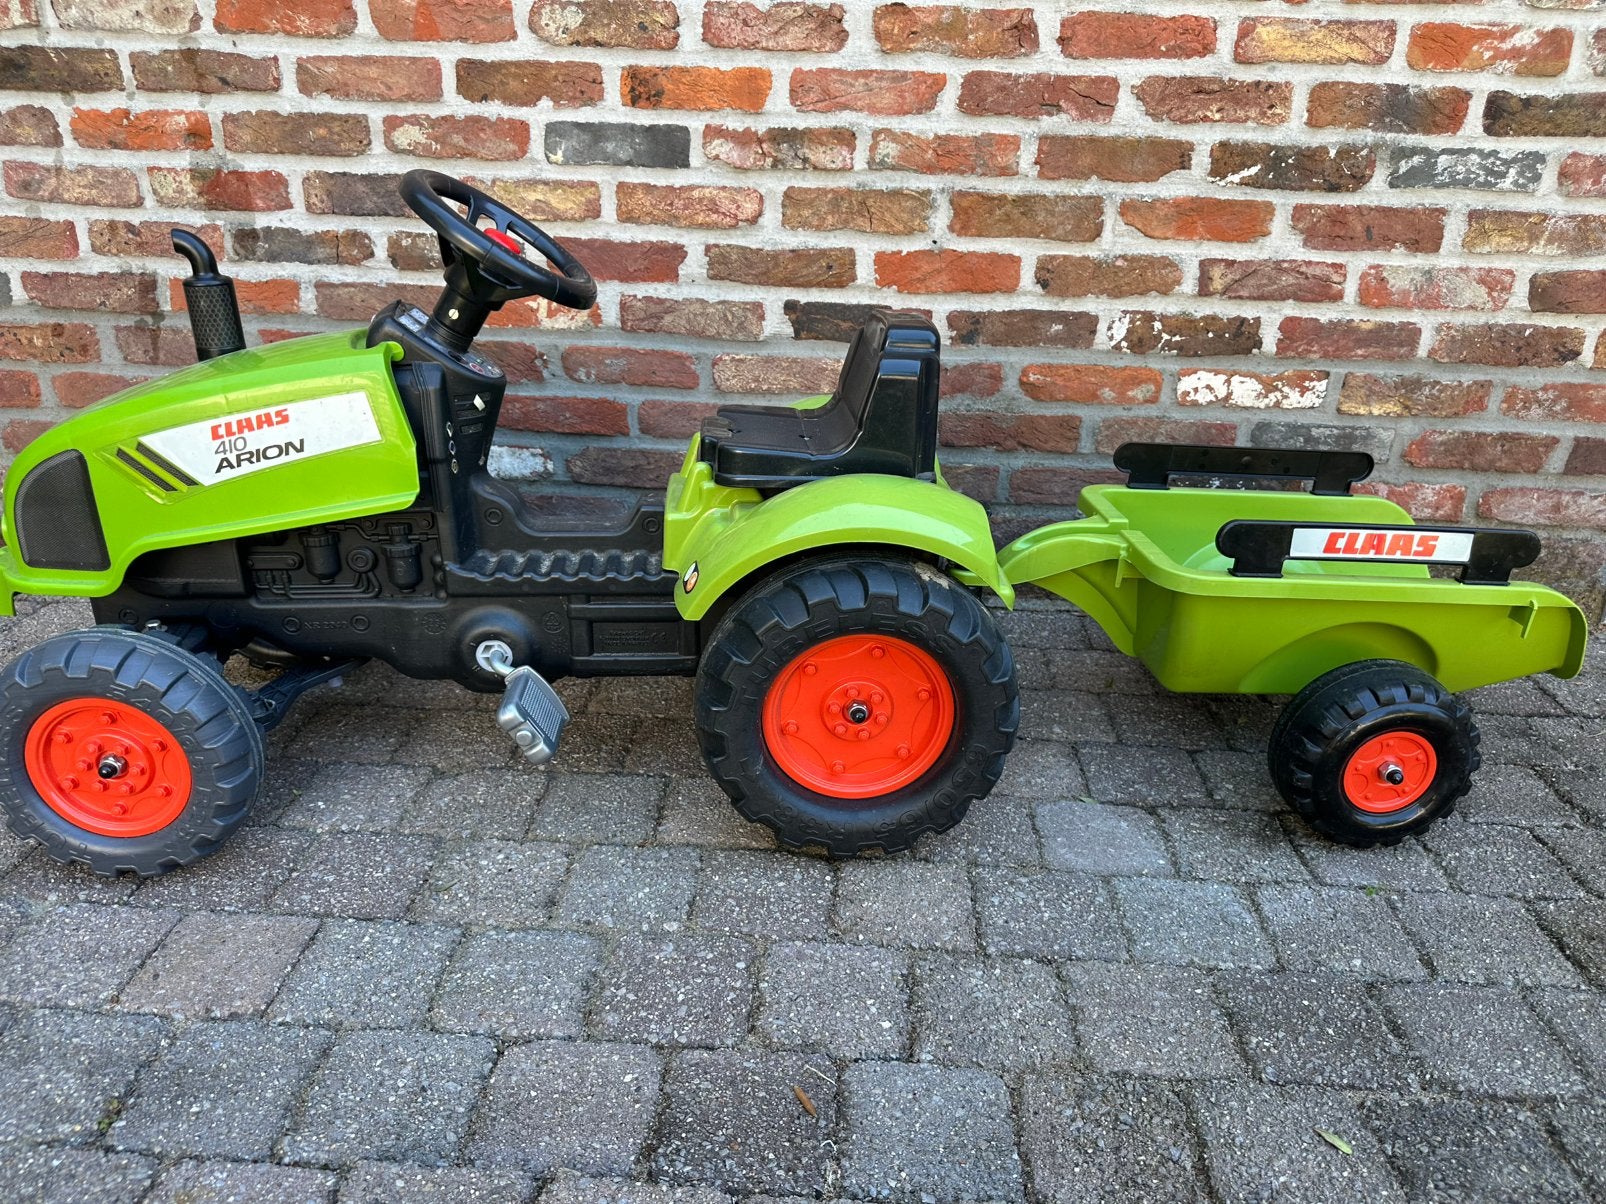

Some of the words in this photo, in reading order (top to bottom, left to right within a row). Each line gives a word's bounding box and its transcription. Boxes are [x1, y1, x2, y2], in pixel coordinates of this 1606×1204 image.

[211, 408, 290, 441] CLAAS
[214, 436, 247, 456] 410
[215, 438, 304, 474] ARION
[1322, 531, 1440, 557] CLAAS
[738, 612, 957, 702] TUBELESS
